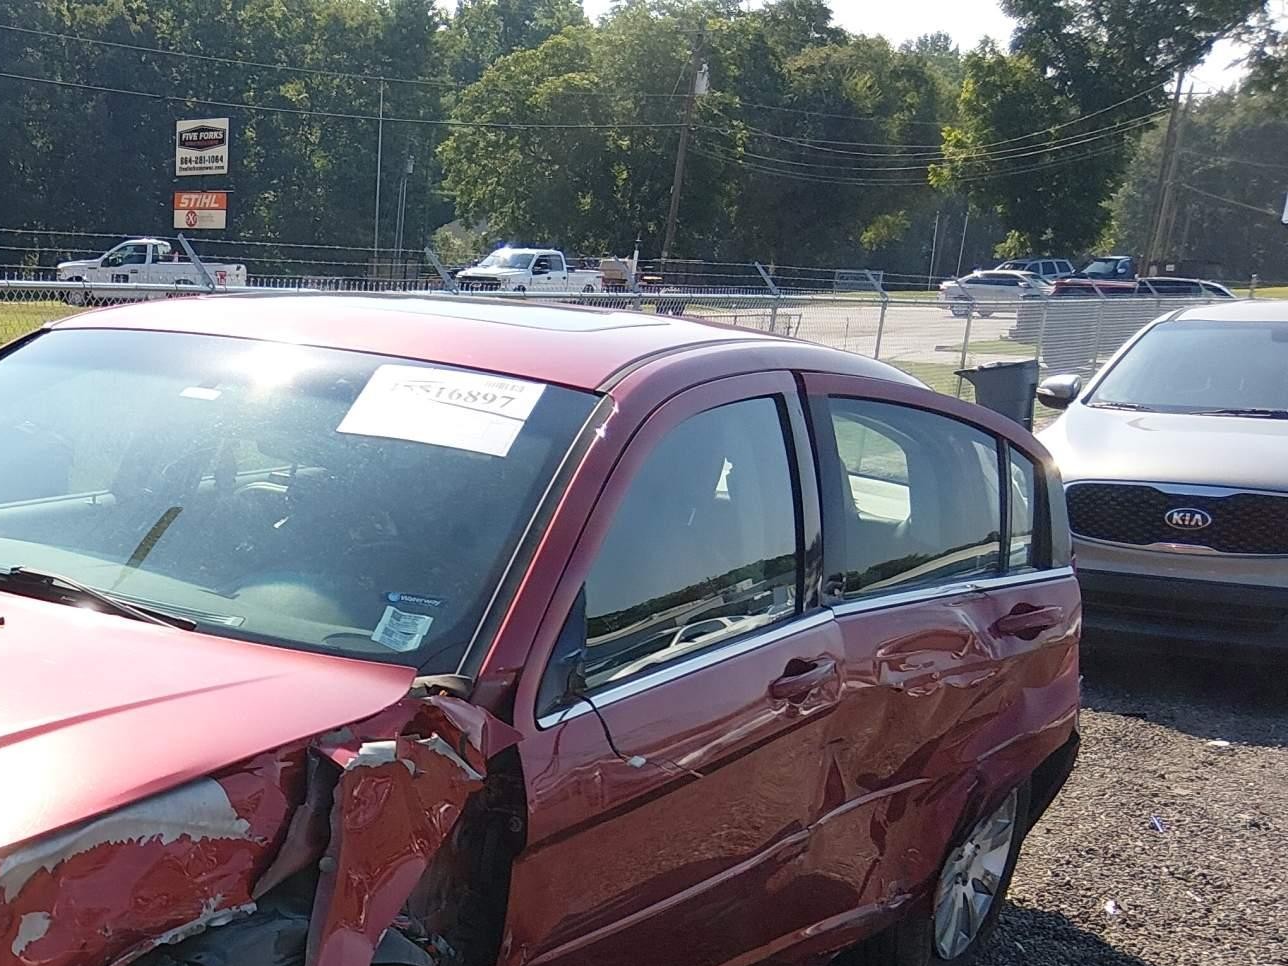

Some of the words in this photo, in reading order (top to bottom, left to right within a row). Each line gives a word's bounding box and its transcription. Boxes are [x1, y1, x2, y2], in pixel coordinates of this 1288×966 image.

[182, 132, 198, 141] FIVE
[199, 131, 223, 140] FORKS
[179, 194, 219, 208] STIHL
[1172, 512, 1203, 526] KIA
